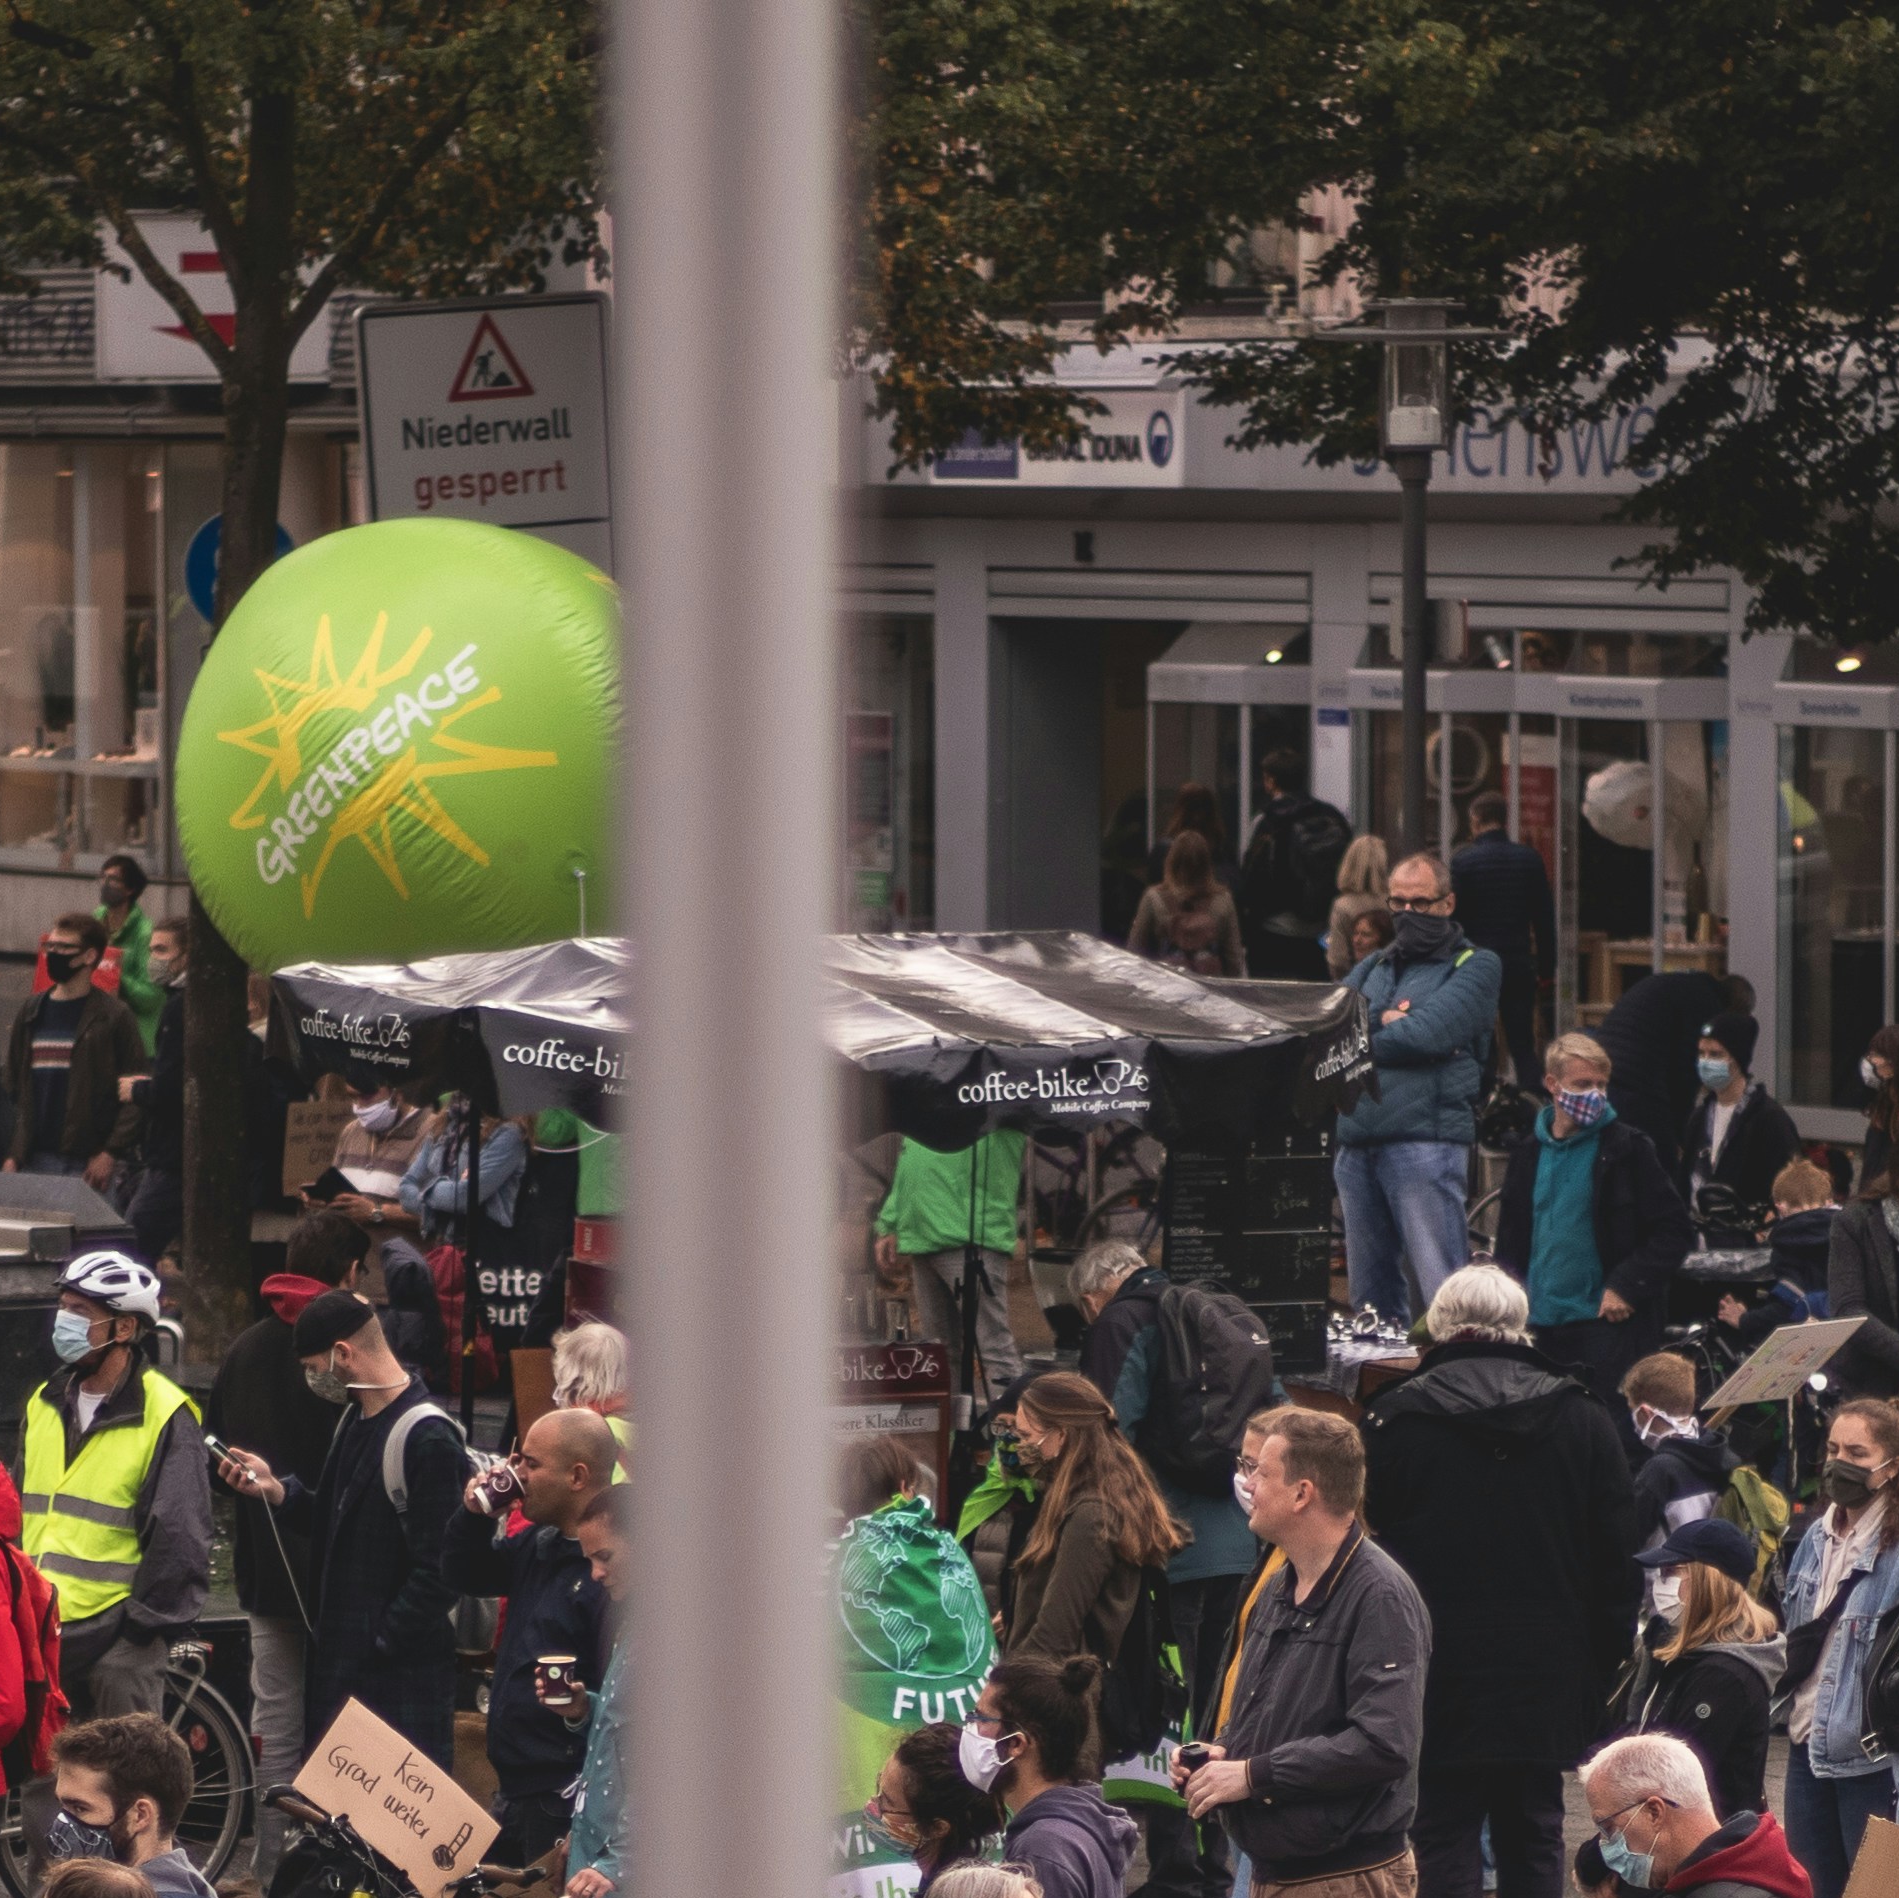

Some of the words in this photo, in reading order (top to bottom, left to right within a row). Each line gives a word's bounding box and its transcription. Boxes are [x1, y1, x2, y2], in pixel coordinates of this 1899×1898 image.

[401, 407, 572, 451] Niederwall
[414, 460, 567, 511] gesperrt
[255, 642, 480, 885] GREENPEACE
[301, 1009, 372, 1045] coffee-bike
[502, 1039, 624, 1080] coffee-bi
[957, 1067, 1090, 1103] coffee-bike
[1050, 1101, 1081, 1114] Mobile
[1081, 1100, 1108, 1114] Coffee
[1110, 1098, 1151, 1113] Company
[476, 1259, 542, 1297] ette
[865, 1412, 925, 1430] Klassiker
[328, 1745, 382, 1795] Grad
[383, 1793, 430, 1840] weiter
[393, 1751, 435, 1803] Kein
